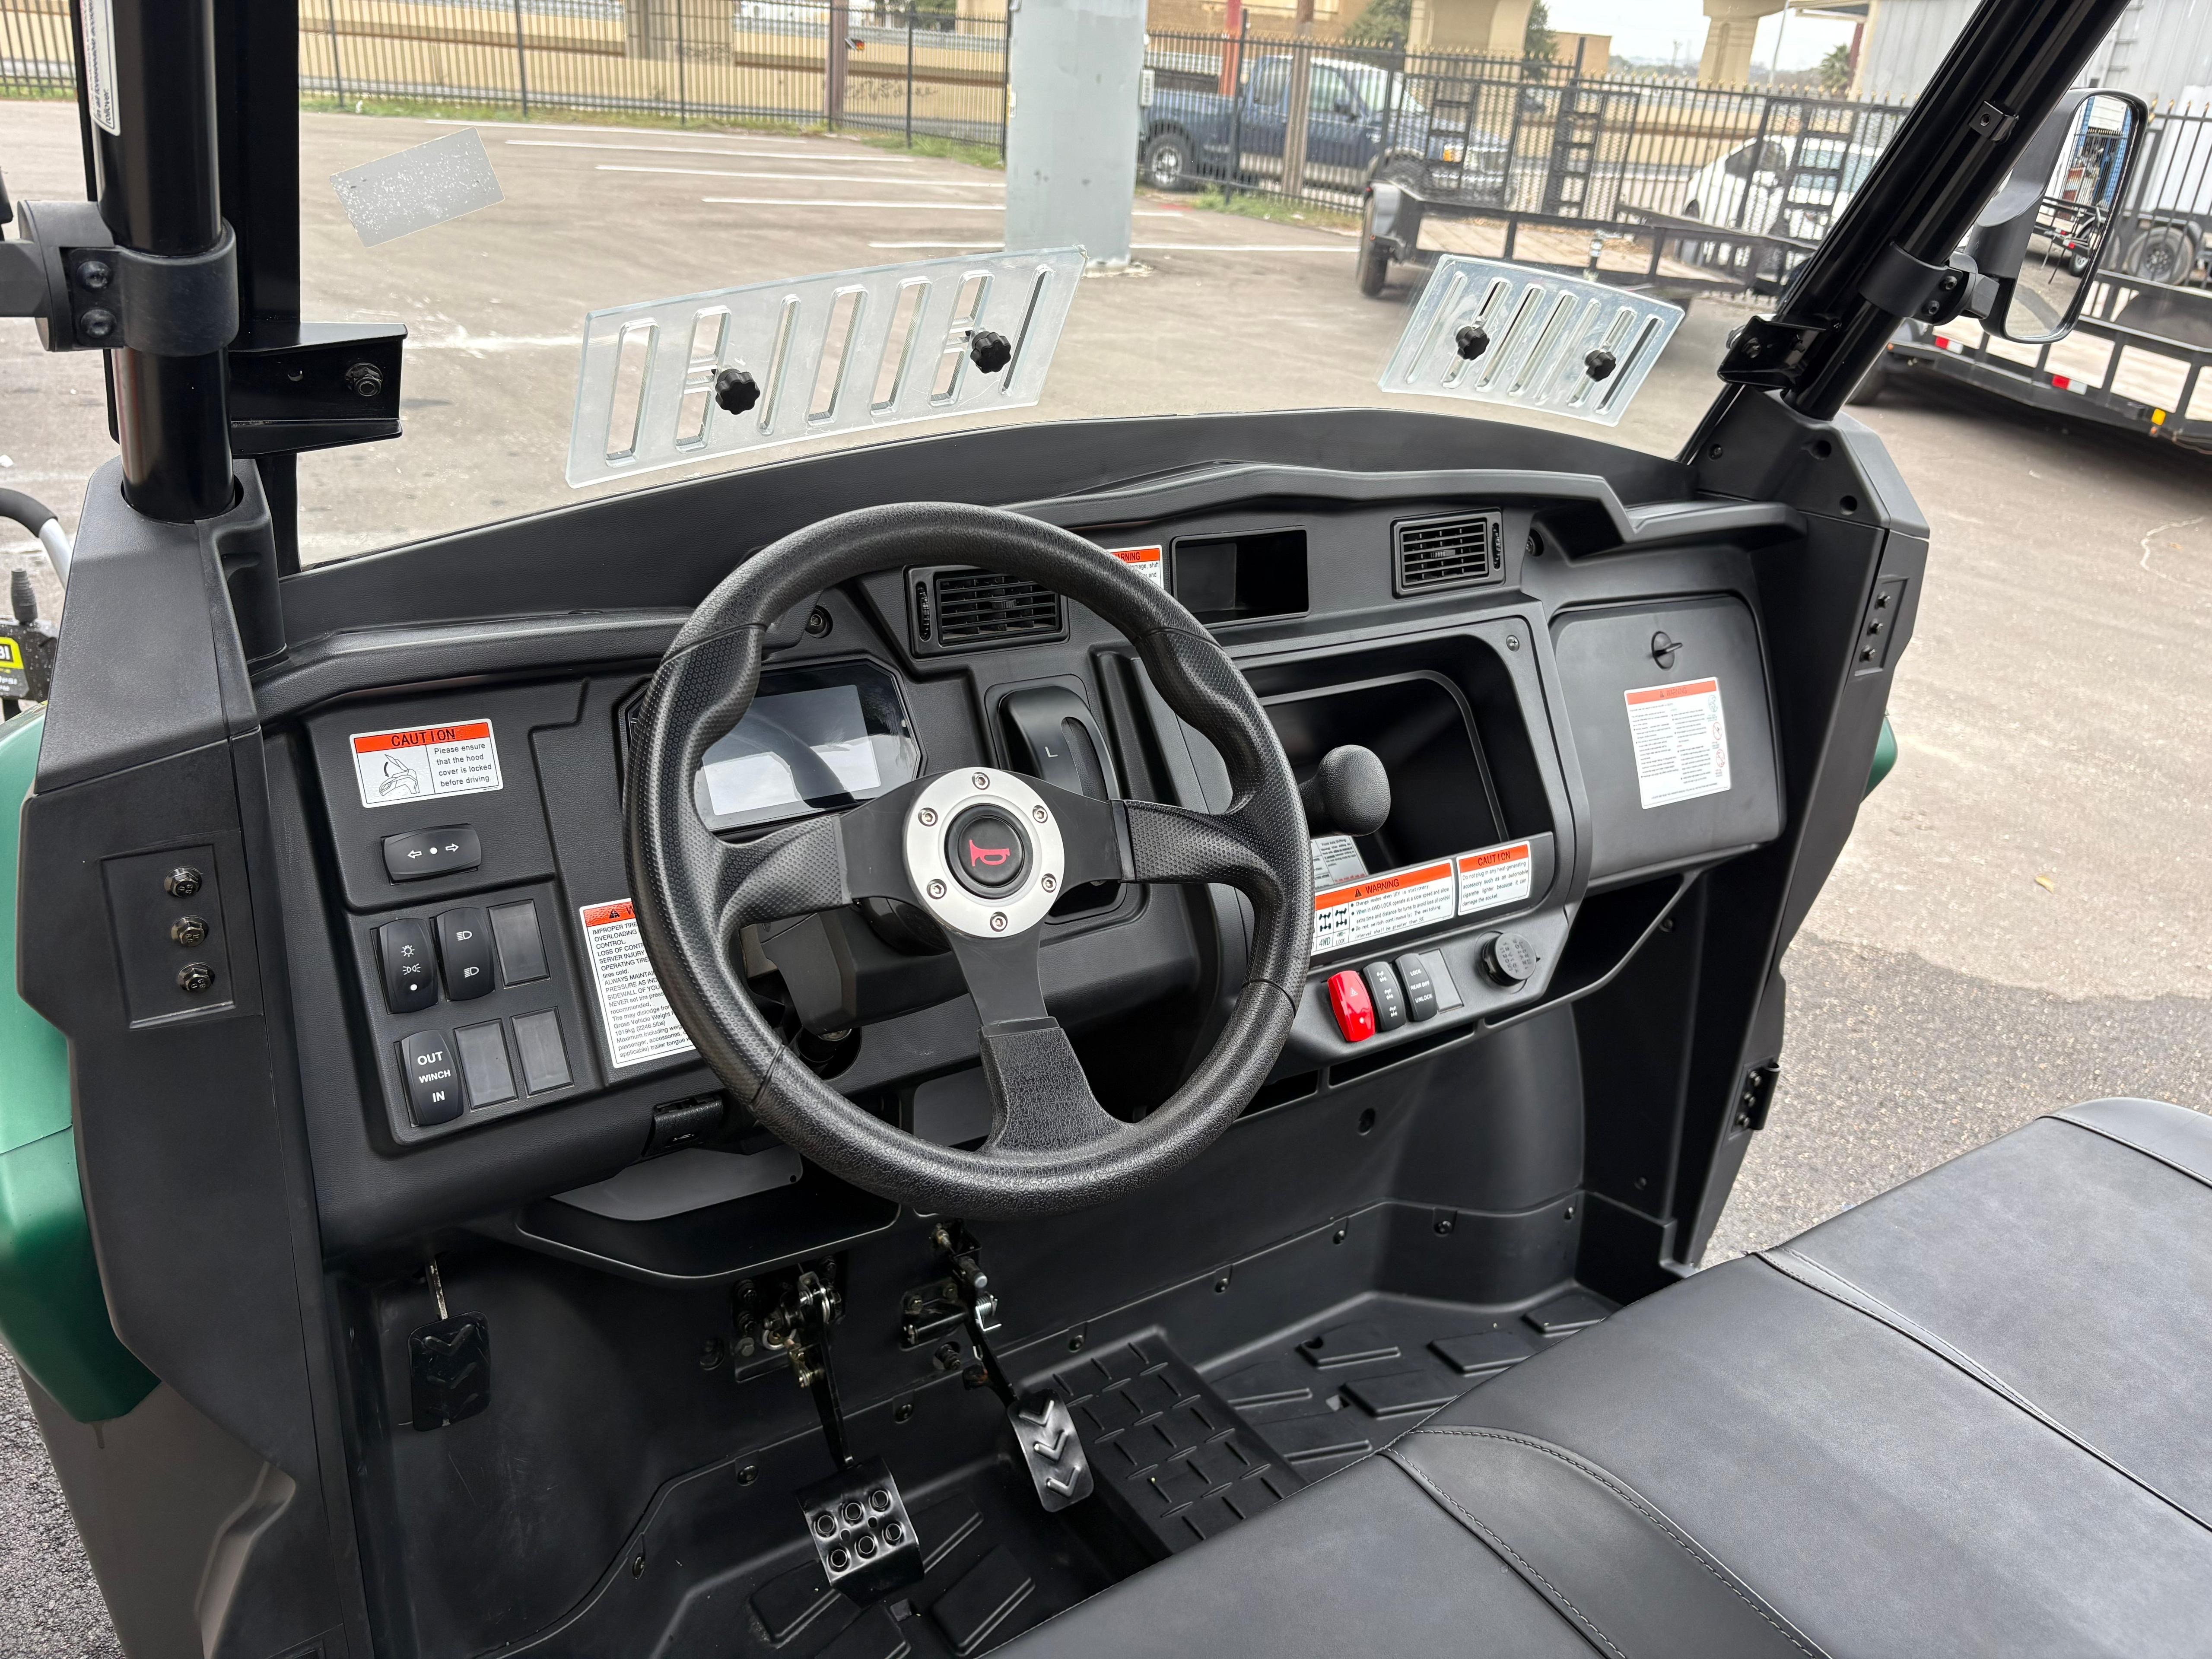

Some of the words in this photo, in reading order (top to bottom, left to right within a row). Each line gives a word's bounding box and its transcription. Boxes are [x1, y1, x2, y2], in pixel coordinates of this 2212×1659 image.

[1116, 552, 1140, 562] RNING
[391, 729, 455, 747] CAUTION
[434, 746, 459, 754] Please
[1045, 747, 1058, 757] L
[436, 757, 451, 766] that
[1478, 851, 1510, 866] CAUTION
[1497, 861, 1526, 872] heat-generating
[1463, 881, 1482, 889] accessory
[1508, 869, 1528, 878] automobile
[1365, 879, 1399, 894] WARNING
[1463, 890, 1479, 899] cigarette
[1372, 903, 1392, 911] 4WD-LOCK
[1462, 899, 1478, 907] damage
[1371, 919, 1384, 928] switch
[1422, 905, 1440, 913] switching
[593, 925, 623, 934] IMPROPER
[594, 929, 637, 942] OVERLOADING
[1319, 937, 1331, 947] 4WD
[599, 955, 623, 964] SERVER
[624, 950, 644, 959] INJURY
[601, 960, 635, 971] OPERATING
[605, 976, 628, 986] ALWAYS
[606, 982, 637, 993] PRESSURE
[607, 990, 637, 1000] SIDEWALL
[1415, 993, 1433, 1003] UNLOCK
[609, 999, 629, 1007] NEVER
[637, 1007, 660, 1017] dislodge
[615, 1027, 635, 1036] 1019kg
[636, 1020, 666, 1032] (2246.5lbs)
[617, 1033, 643, 1043] Maximum
[644, 1028, 668, 1037] including
[619, 1040, 648, 1051] passenger,
[649, 1032, 682, 1043] accessories,
[620, 1046, 649, 1058] applicable)
[667, 1038, 685, 1046] tongue
[417, 1051, 443, 1065] OUT
[419, 1069, 451, 1083] WINCH
[432, 1090, 445, 1102] IN
